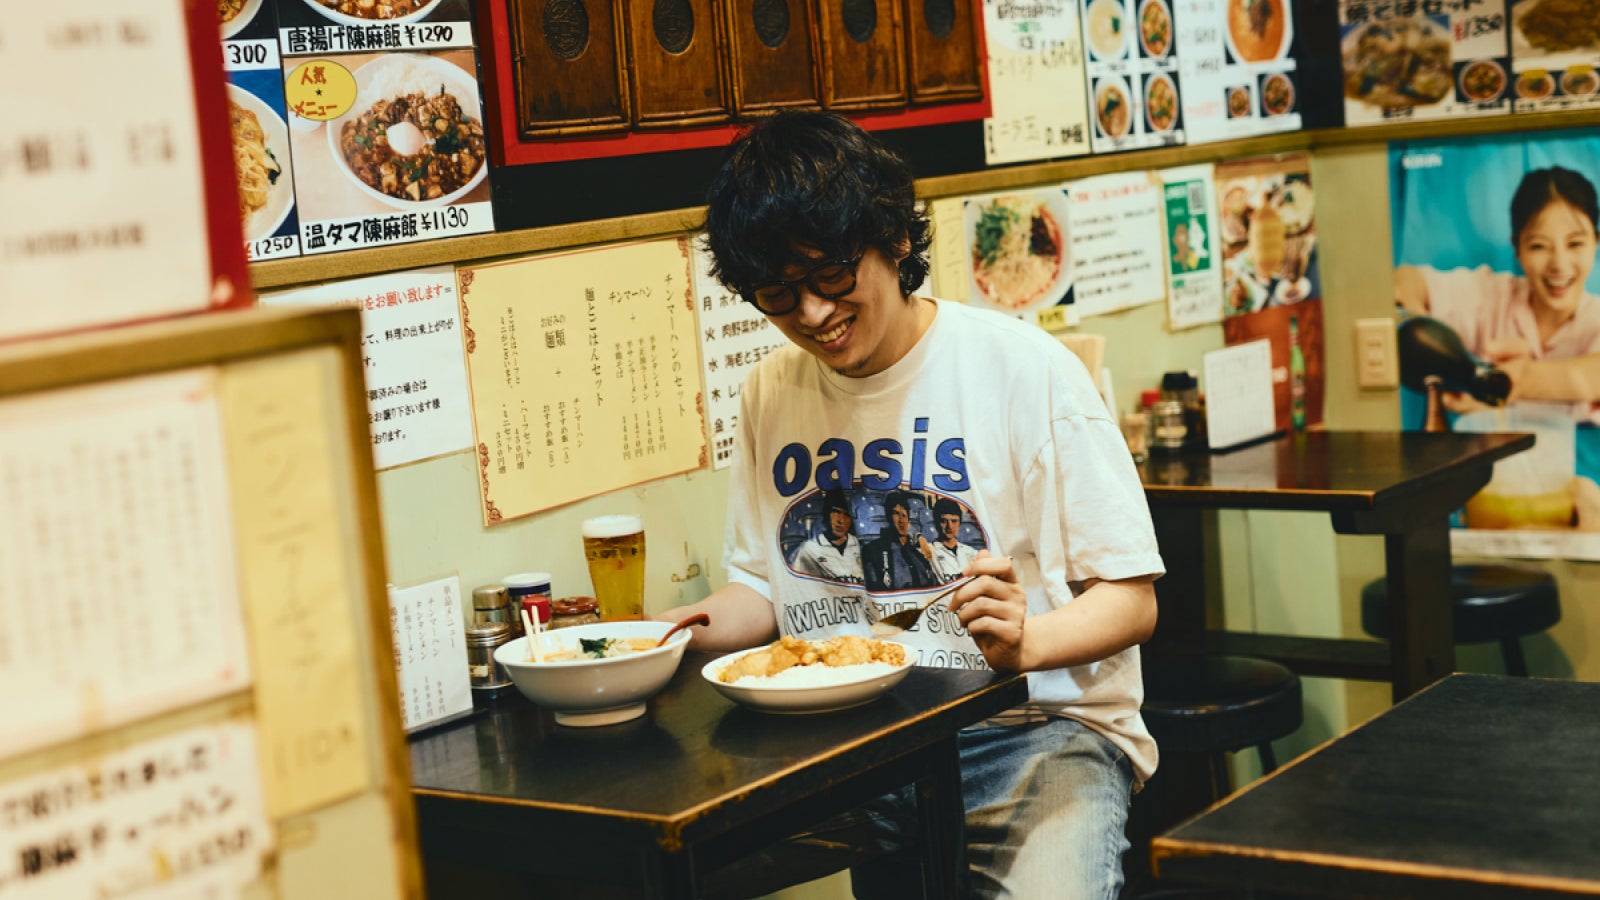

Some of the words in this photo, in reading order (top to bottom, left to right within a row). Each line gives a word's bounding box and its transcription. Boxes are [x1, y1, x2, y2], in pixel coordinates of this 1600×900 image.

[287, 24, 401, 53] 唐揚げ陳麻飯
[404, 25, 453, 46] ¥1290
[300, 66, 326, 86] 人気
[294, 101, 338, 118] メニュー
[305, 214, 418, 249] 温タマ陳麻飯
[421, 206, 469, 232] ¥1130
[608, 286, 652, 304] チンマーハン
[703, 295, 713, 312] 月
[705, 326, 716, 342] 火
[664, 272, 686, 417] チンマーハンのセット
[708, 357, 719, 373] 水
[711, 387, 722, 403] 木
[714, 417, 725, 433] 金
[370, 428, 407, 445] おります。
[772, 416, 970, 497] oasis
[925, 604, 972, 637] STO
